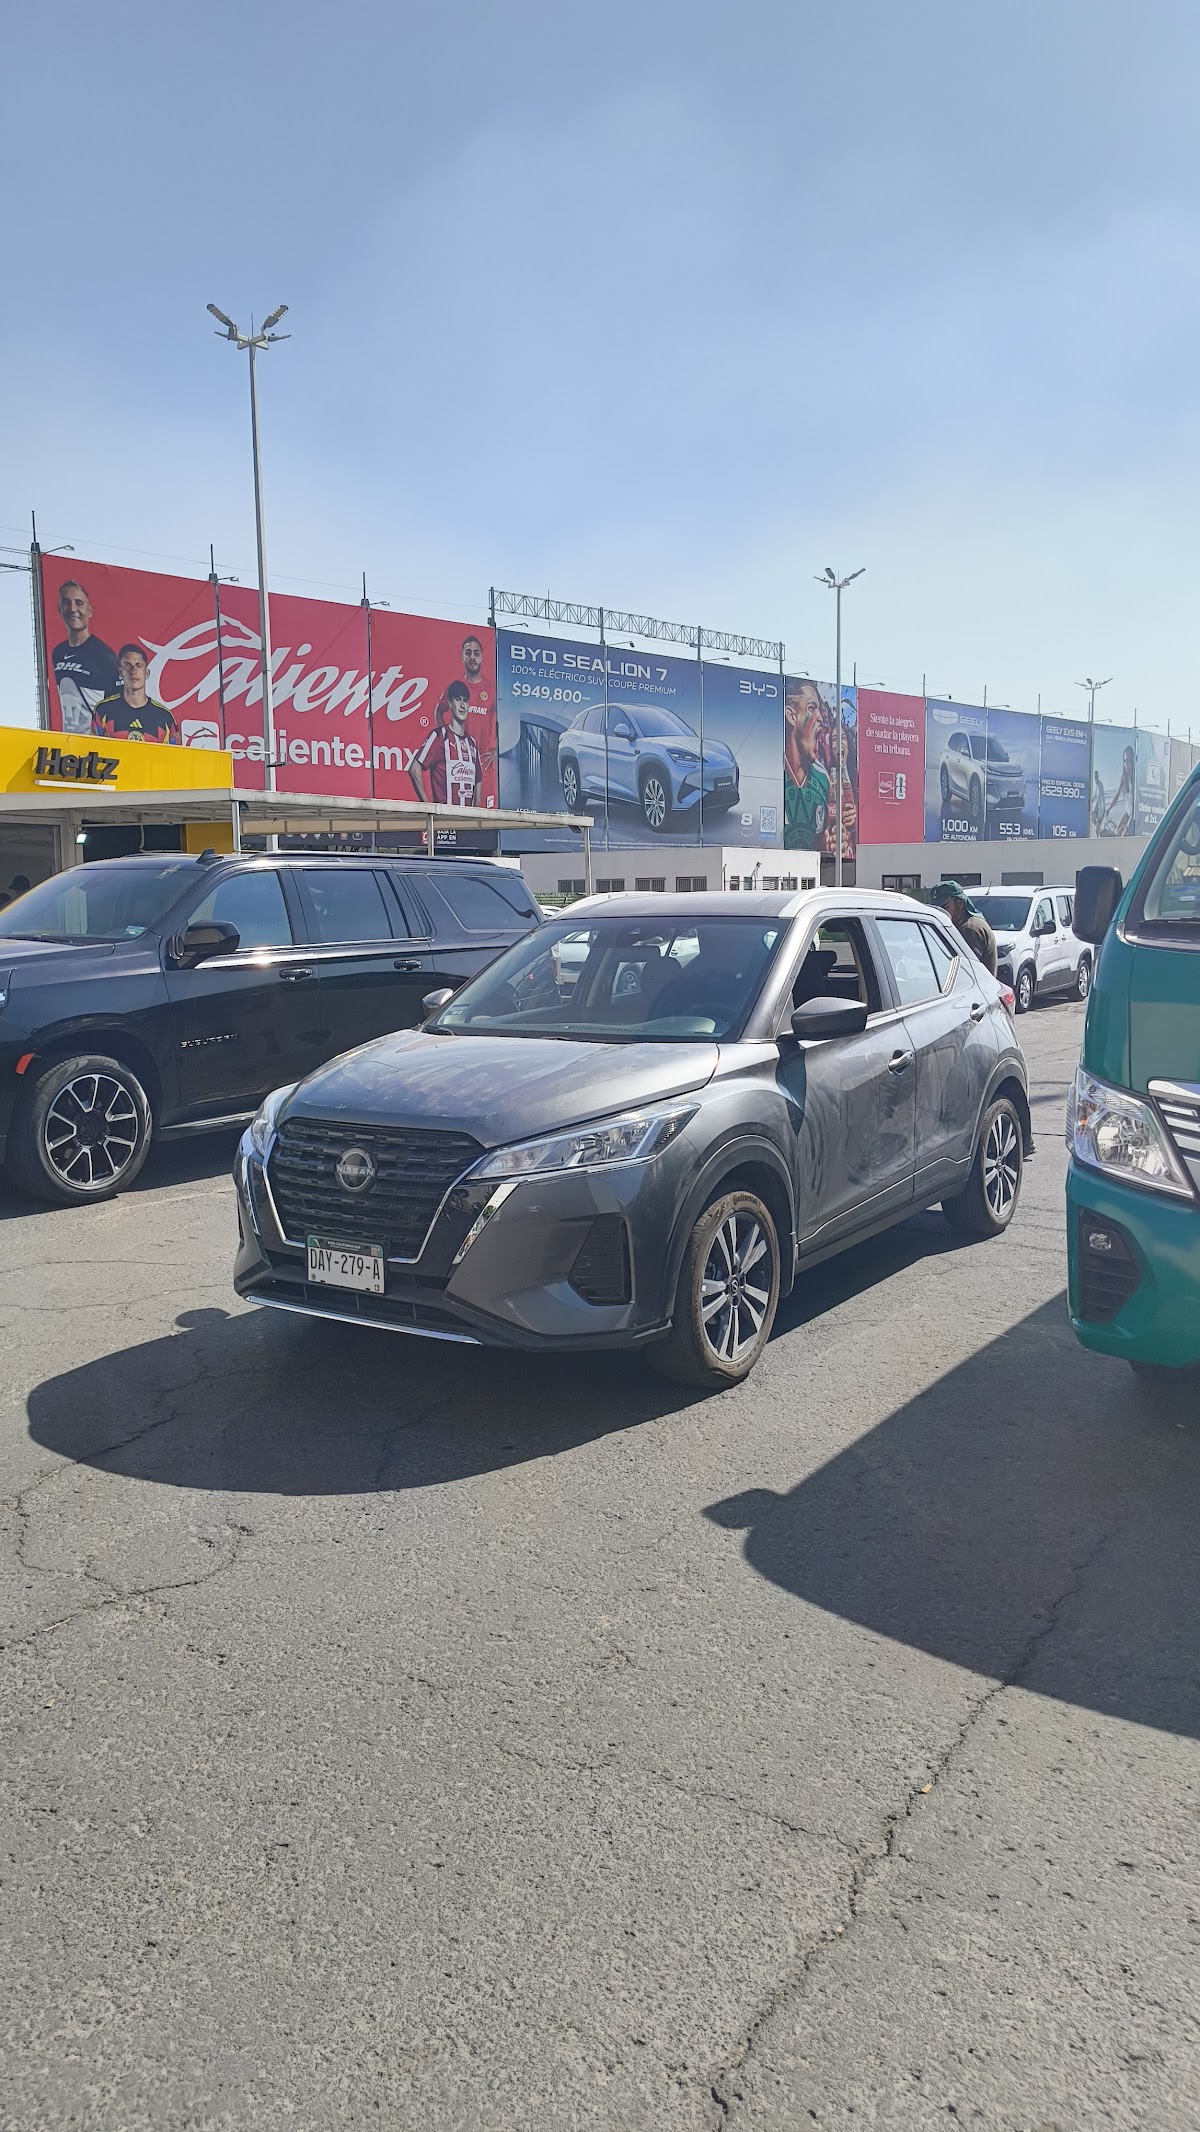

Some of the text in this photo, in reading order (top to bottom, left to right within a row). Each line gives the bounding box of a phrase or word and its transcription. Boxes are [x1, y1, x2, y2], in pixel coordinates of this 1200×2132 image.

[54, 661, 83, 673] DHL
[138, 614, 429, 721] Caliente
[510, 644, 668, 682] BYD SEALION 7
[511, 664, 676, 696] 100% ELÉCTRICO SUV COUPE PREMIUM
[511, 681, 582, 704] $949,800
[739, 679, 778, 698] BYD
[870, 713, 889, 725] Siente
[889, 715, 895, 725] la
[960, 715, 984, 726] GEELY
[865, 727, 919, 743] de sudar la playera
[1045, 725, 1063, 735] GEELY
[874, 743, 911, 756] en la tribuna.
[35, 746, 120, 780] Hertz
[1041, 785, 1080, 799] $529,990
[941, 818, 979, 834] 1,000 KM
[999, 823, 1021, 835] 55.3
[1052, 825, 1077, 838] 105 KM
[942, 833, 950, 841] DE
[335, 1163, 375, 1176] NISSAN
[310, 1248, 380, 1280] DAY-279-A
